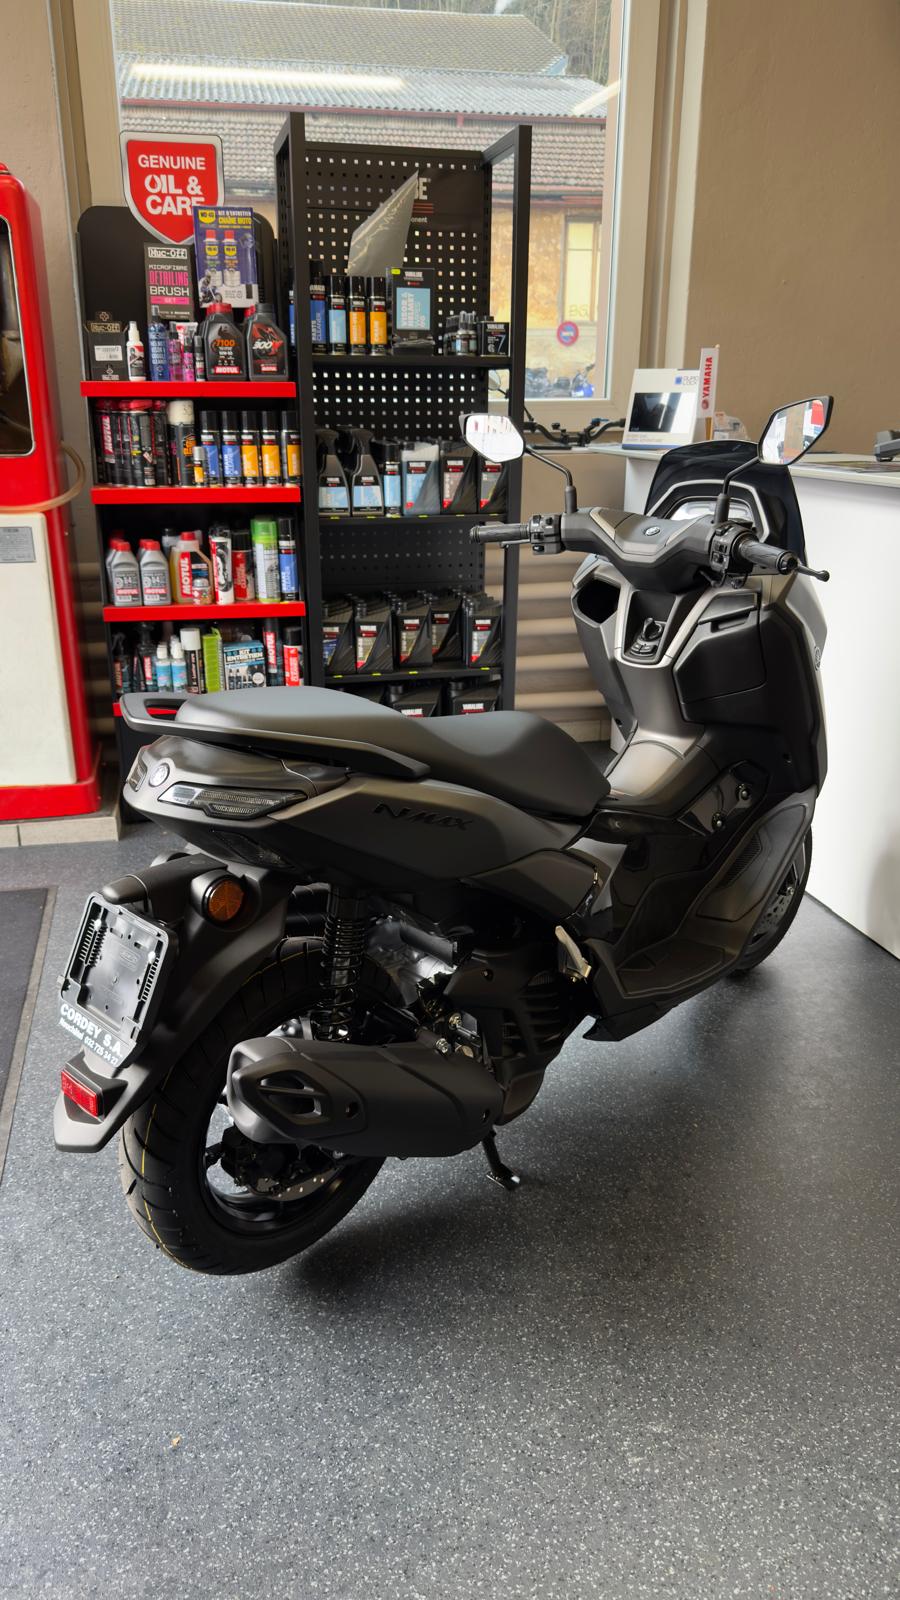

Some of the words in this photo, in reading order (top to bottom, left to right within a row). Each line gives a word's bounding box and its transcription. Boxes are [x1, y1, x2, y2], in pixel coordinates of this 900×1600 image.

[138, 154, 206, 170] GENUINE
[144, 174, 182, 195] OIL
[187, 176, 203, 195] &
[148, 248, 187, 259] Muc-Off
[149, 271, 189, 286] DETAILING
[150, 286, 190, 297] BRUSH
[216, 339, 236, 347] 7100
[215, 366, 239, 374] MOTUL
[702, 356, 713, 398] YAMAHA
[103, 416, 113, 453] MOTUL
[181, 558, 191, 594] MOTUL
[266, 633, 276, 664] MOTUL
[61, 1003, 102, 1038] CORDEY
[103, 1034, 123, 1058] S.A.
